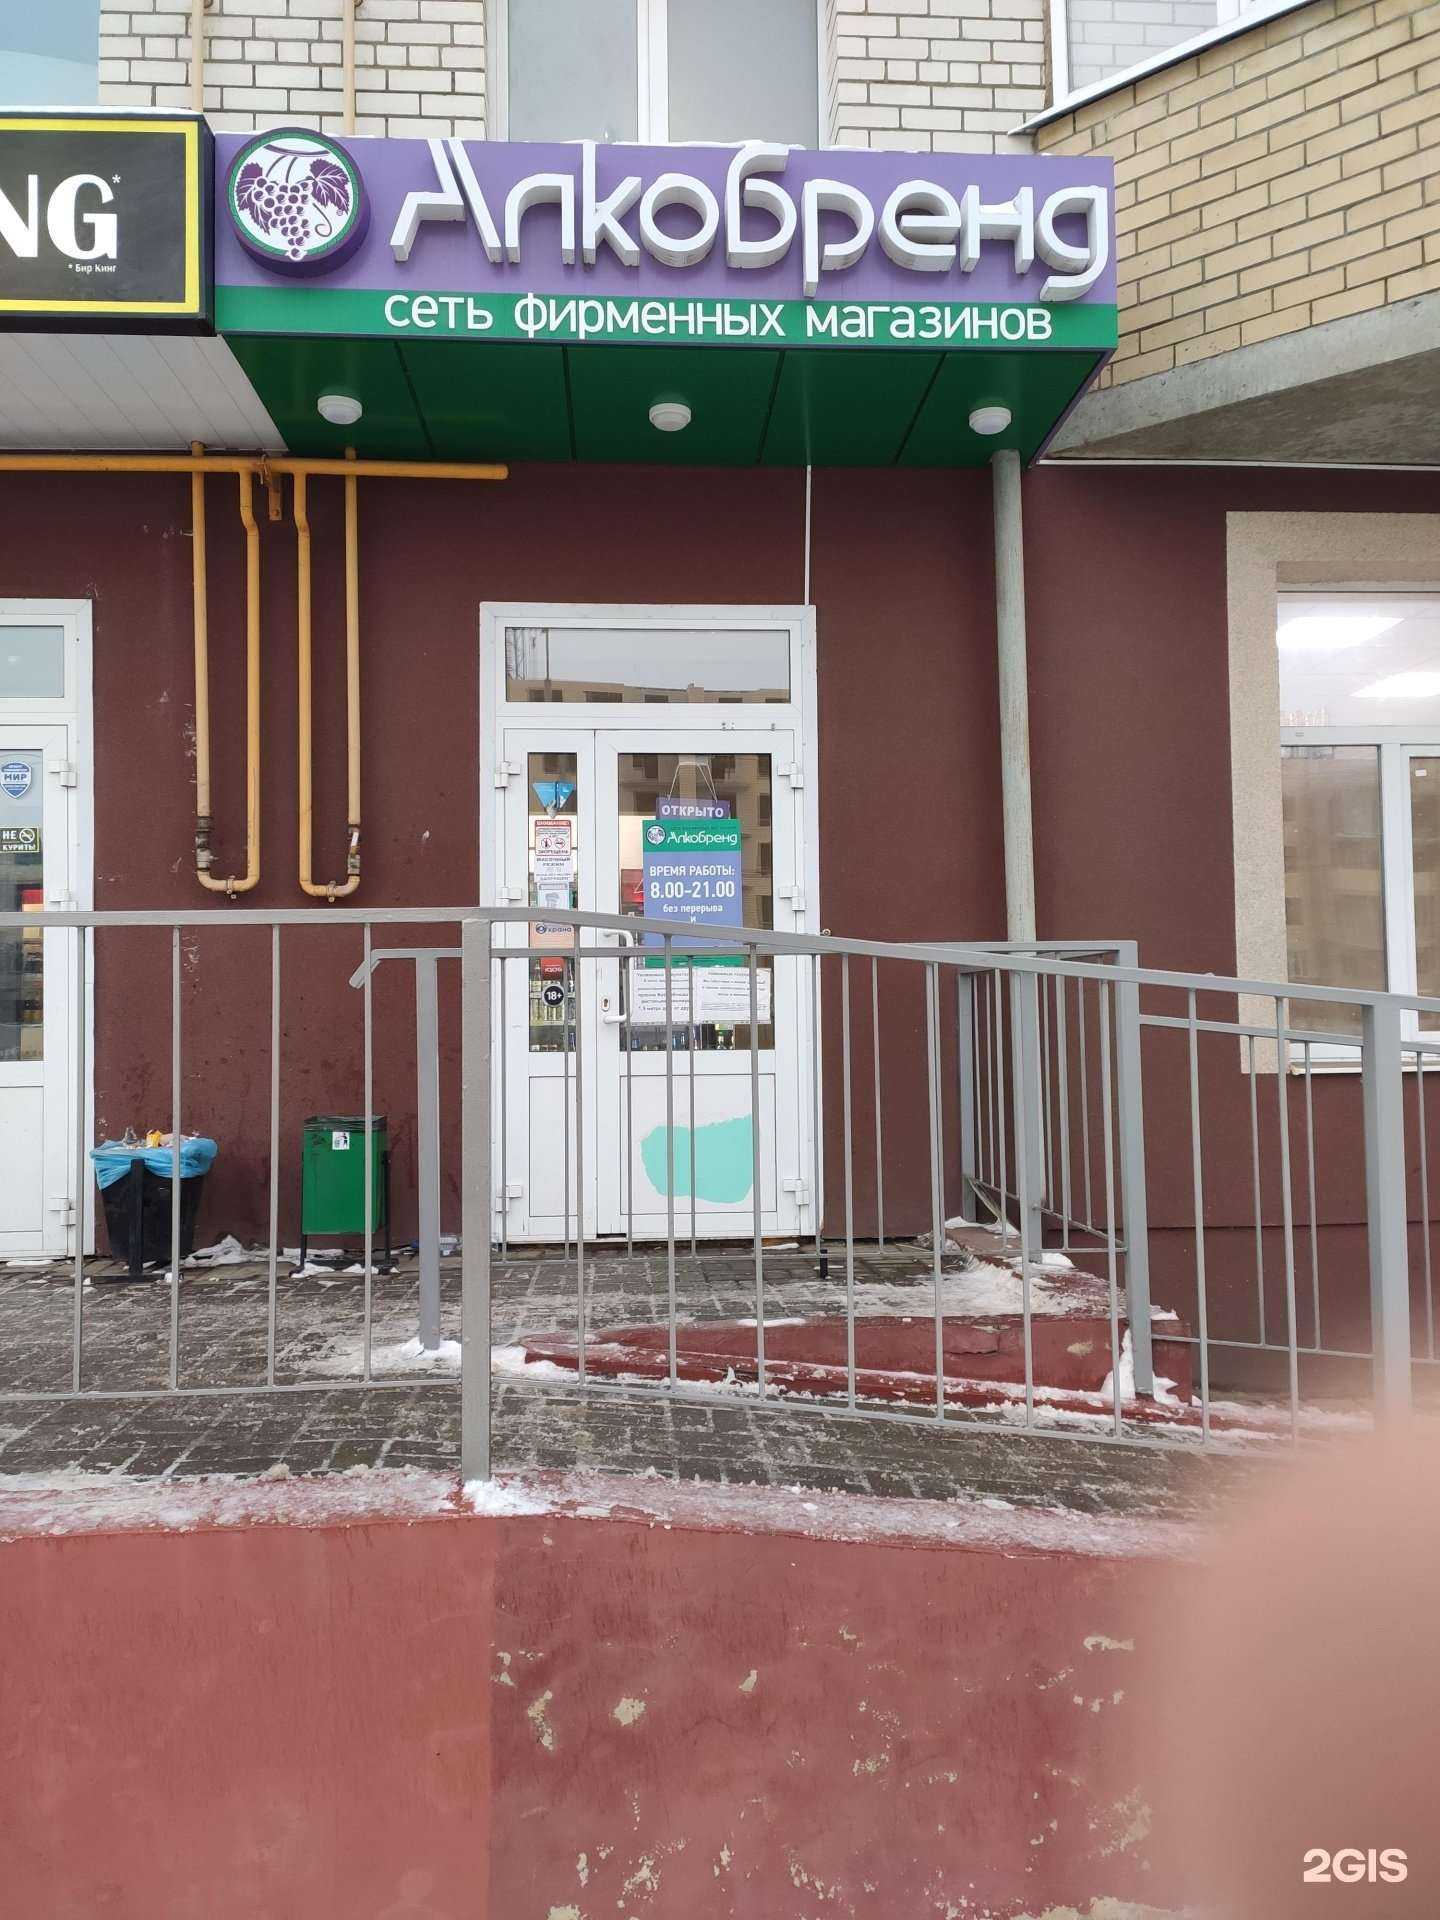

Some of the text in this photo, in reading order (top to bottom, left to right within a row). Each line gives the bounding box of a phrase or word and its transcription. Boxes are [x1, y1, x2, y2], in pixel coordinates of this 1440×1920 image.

[390, 138, 1108, 301] Алкобренд
[95, 264, 117, 273] Кинг
[384, 292, 1053, 341] сеть фирменных магазинов
[4, 773, 27, 781] МИР
[661, 805, 724, 818] ОТКРЫТО
[2, 830, 17, 840] НЕ
[667, 831, 737, 846] Алкобренд
[649, 865, 735, 877] ВРЕМЯ РАБОТЫ:
[650, 881, 735, 899] 8.00-21.00
[663, 904, 723, 914] без перерыва
[546, 991, 562, 1001] 18+
